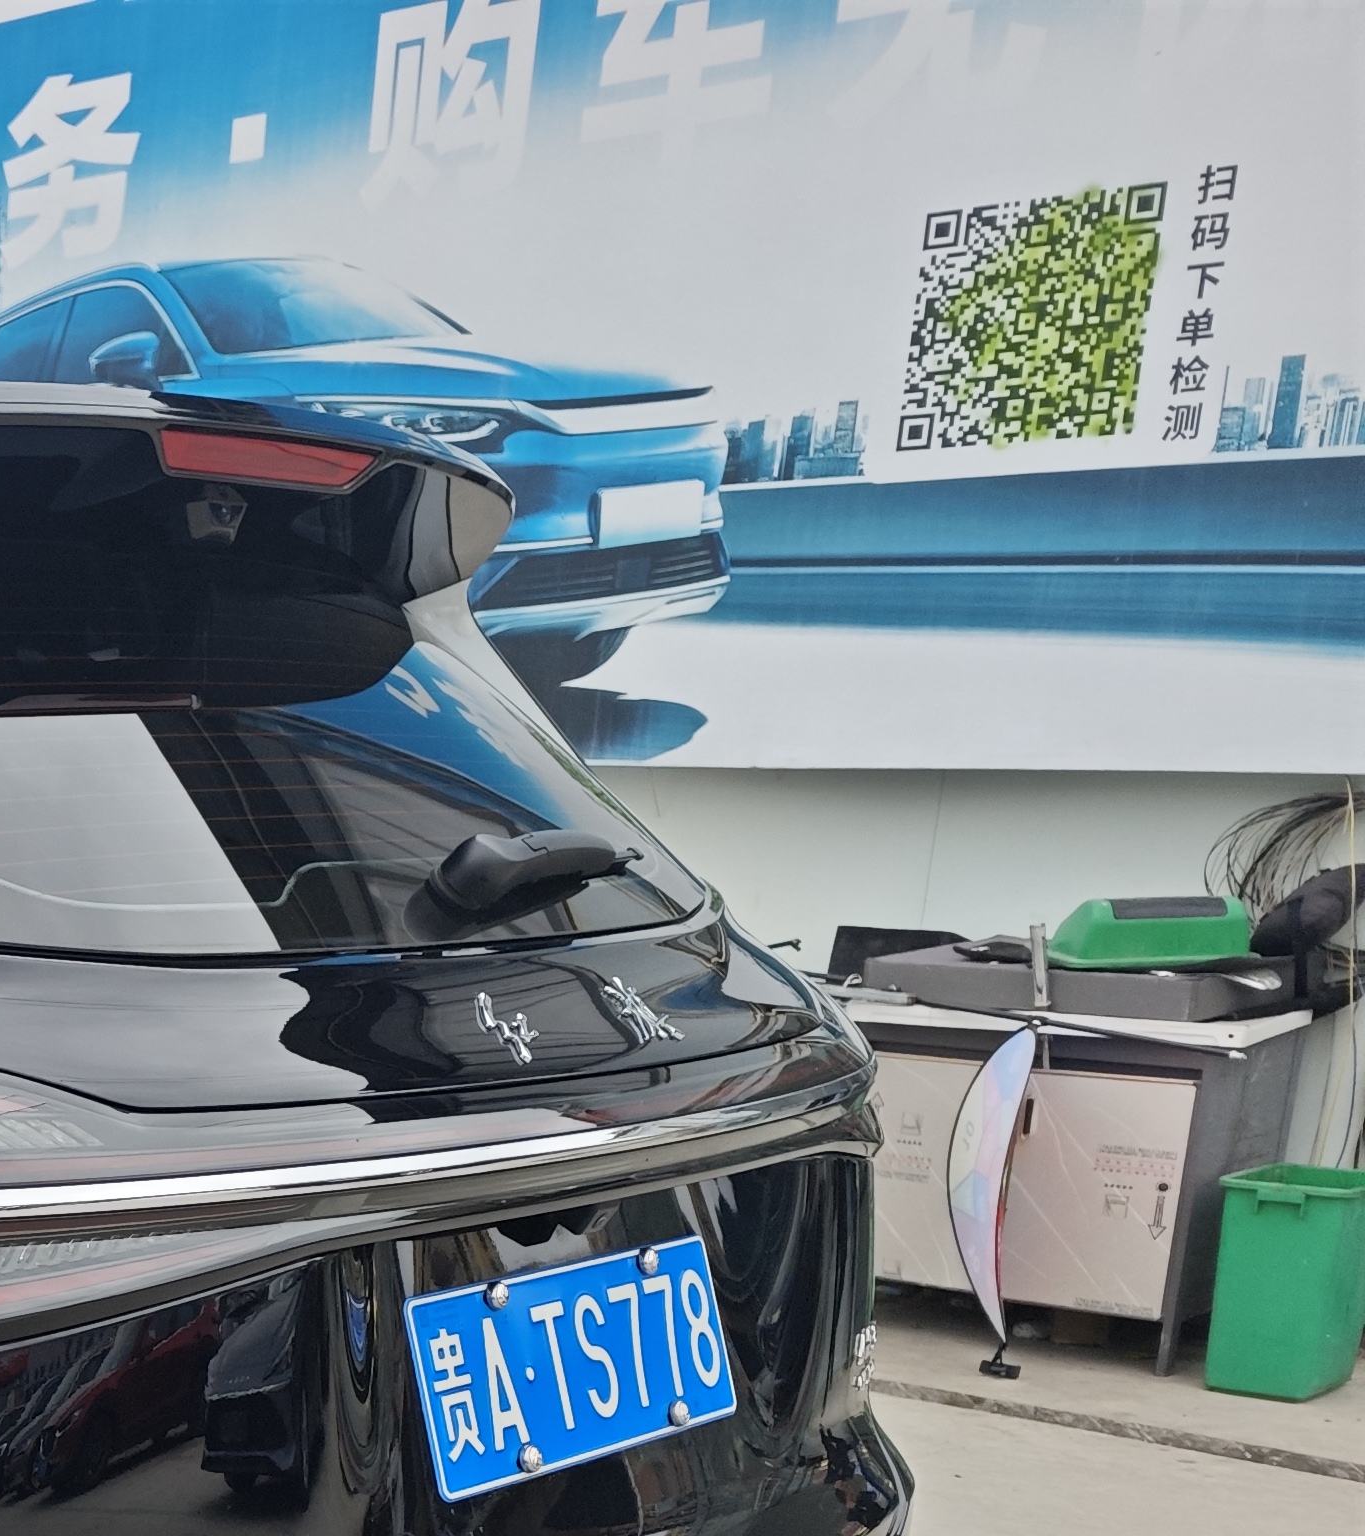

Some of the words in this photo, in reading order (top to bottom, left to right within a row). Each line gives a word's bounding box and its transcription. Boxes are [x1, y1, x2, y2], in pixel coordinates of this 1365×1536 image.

[1162, 164, 1238, 441] 扫码下单检测
